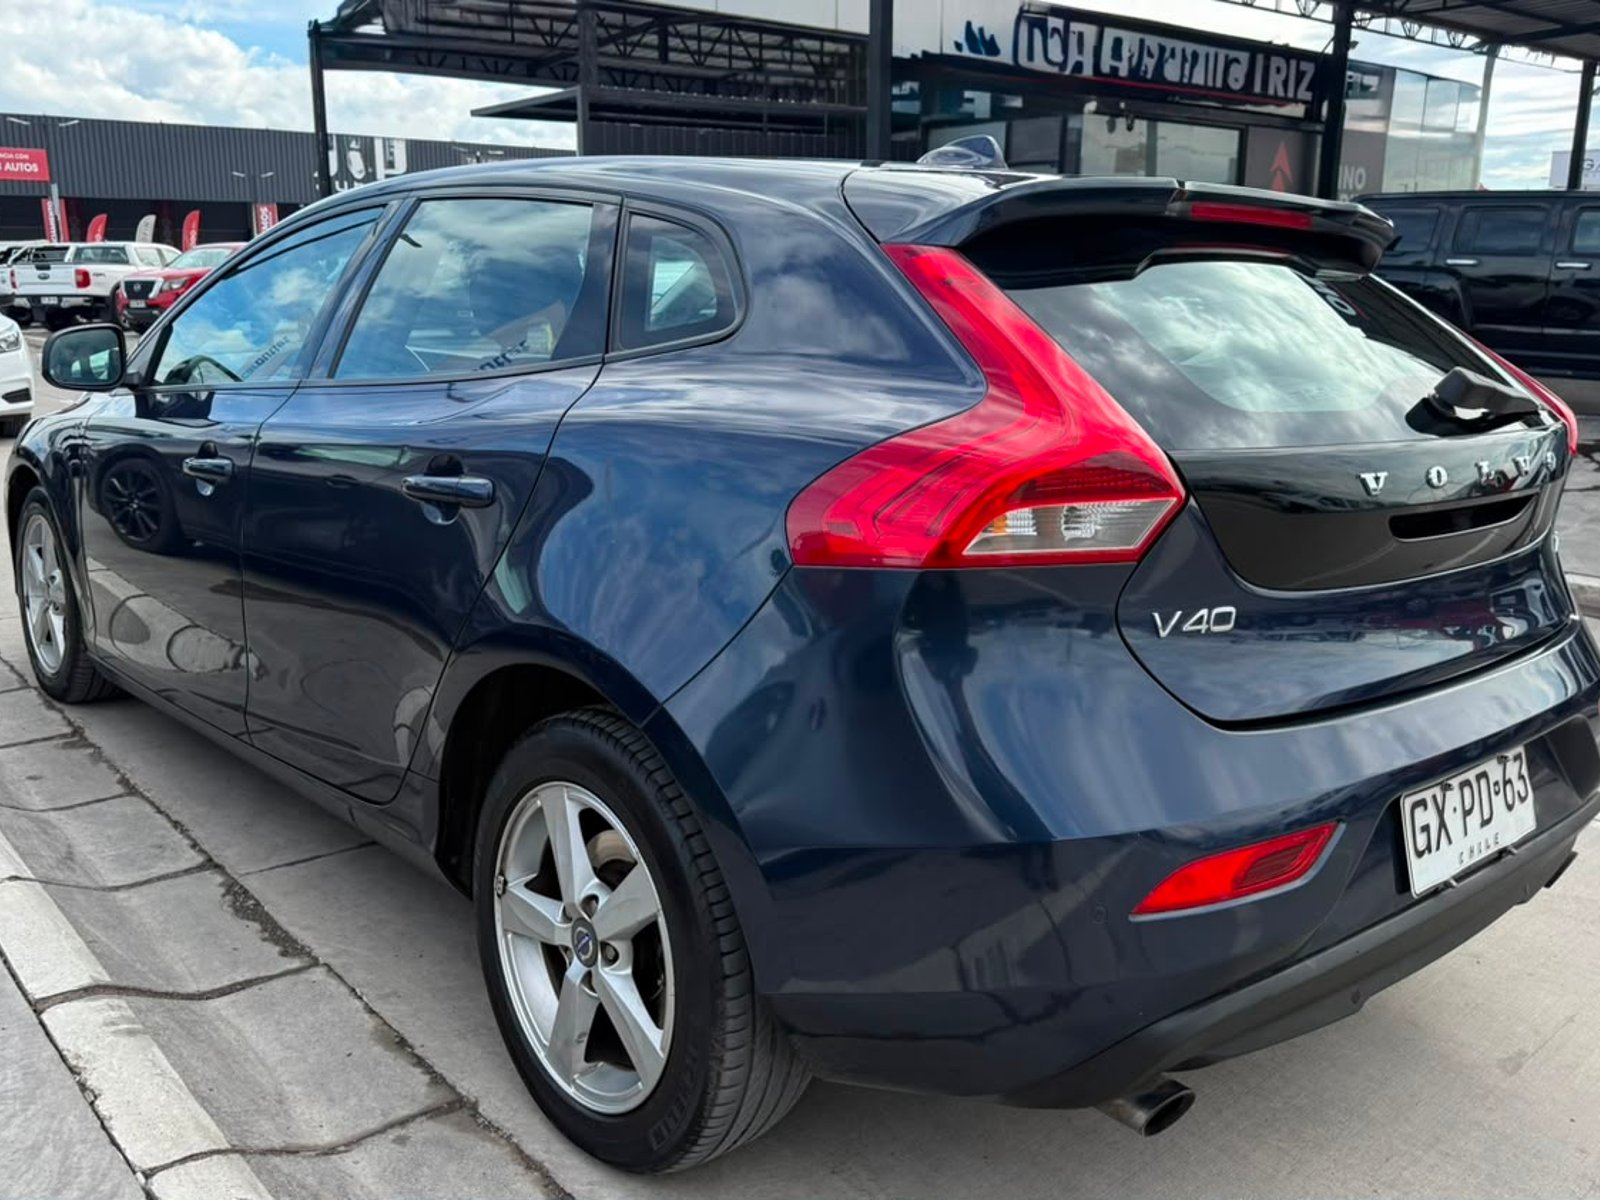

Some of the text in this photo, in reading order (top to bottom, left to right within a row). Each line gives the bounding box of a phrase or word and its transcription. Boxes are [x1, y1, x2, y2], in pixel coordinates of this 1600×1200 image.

[4, 162, 39, 173] AUTOS
[1358, 451, 1557, 496] VOLVO
[1152, 606, 1236, 638] V40
[1459, 832, 1500, 865] CHILE
